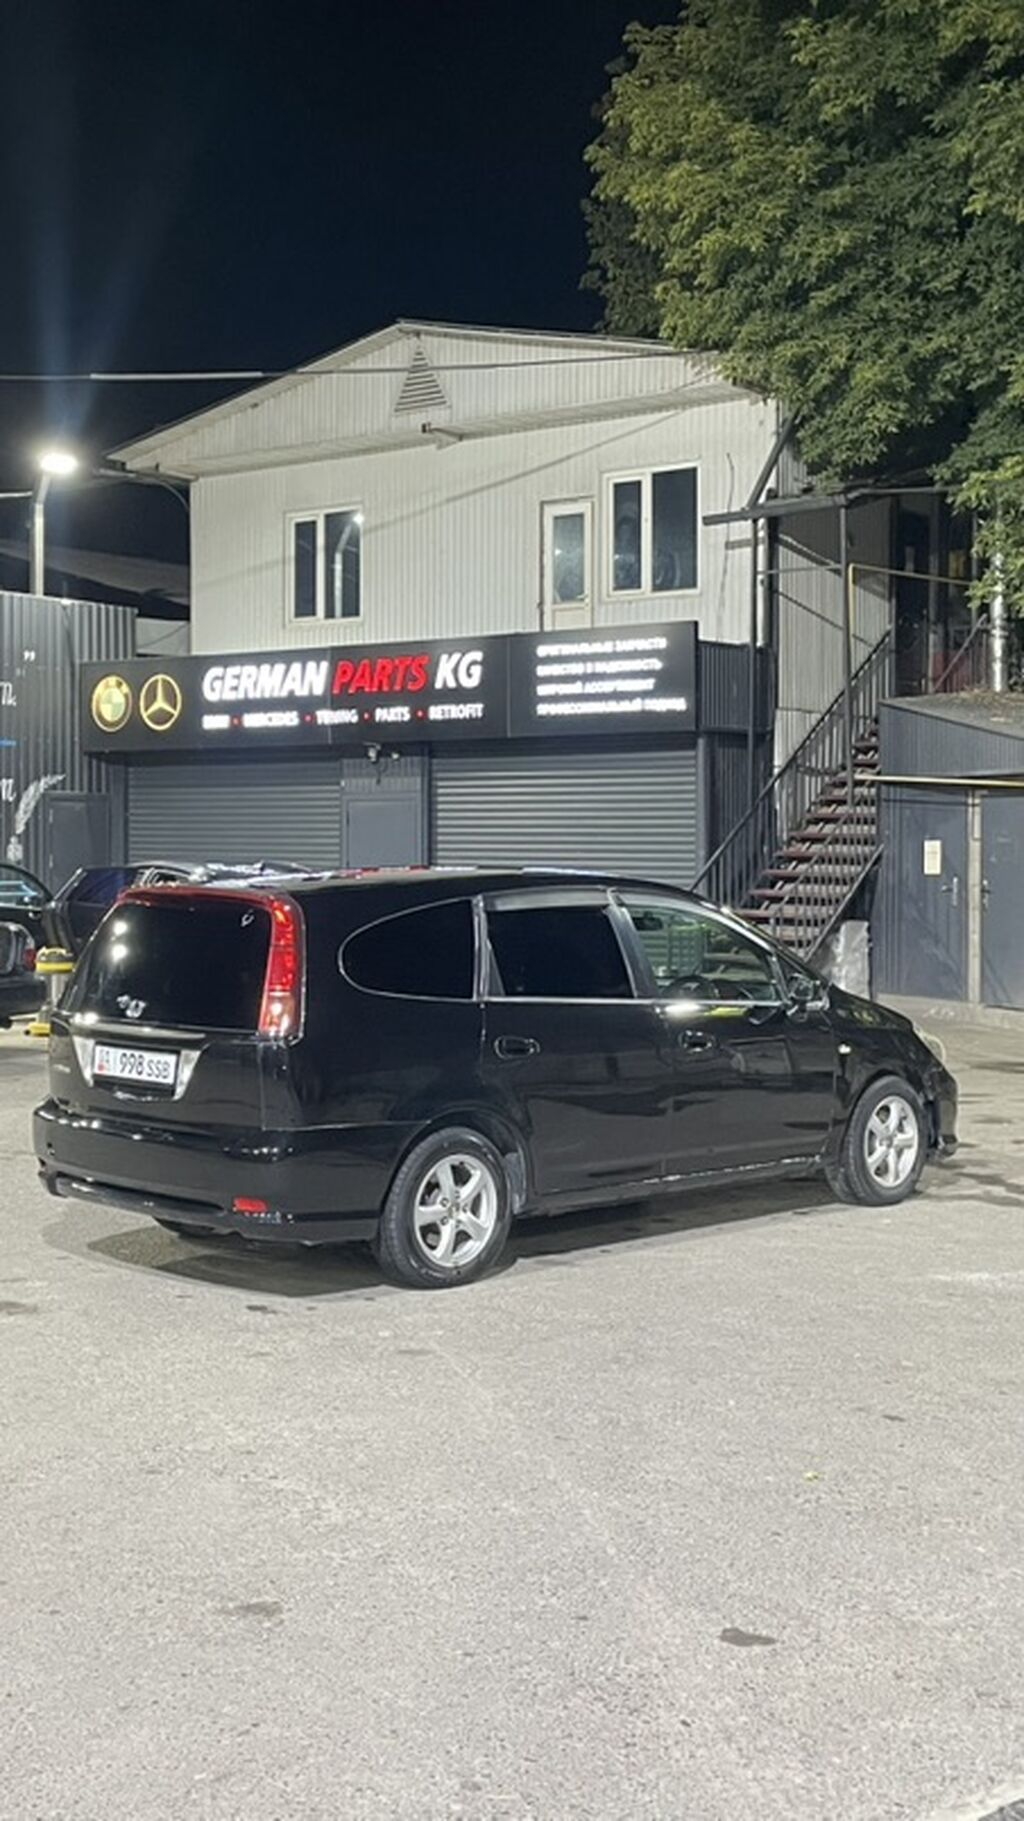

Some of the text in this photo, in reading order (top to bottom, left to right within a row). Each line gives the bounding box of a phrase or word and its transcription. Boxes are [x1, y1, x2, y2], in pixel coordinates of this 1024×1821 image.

[202, 651, 483, 702] GERMAN PARTS KG
[374, 706, 411, 723] PARTS
[428, 703, 484, 721] RETROFIT
[119, 1052, 145, 1076] 998
[146, 1058, 171, 1080] SSB
